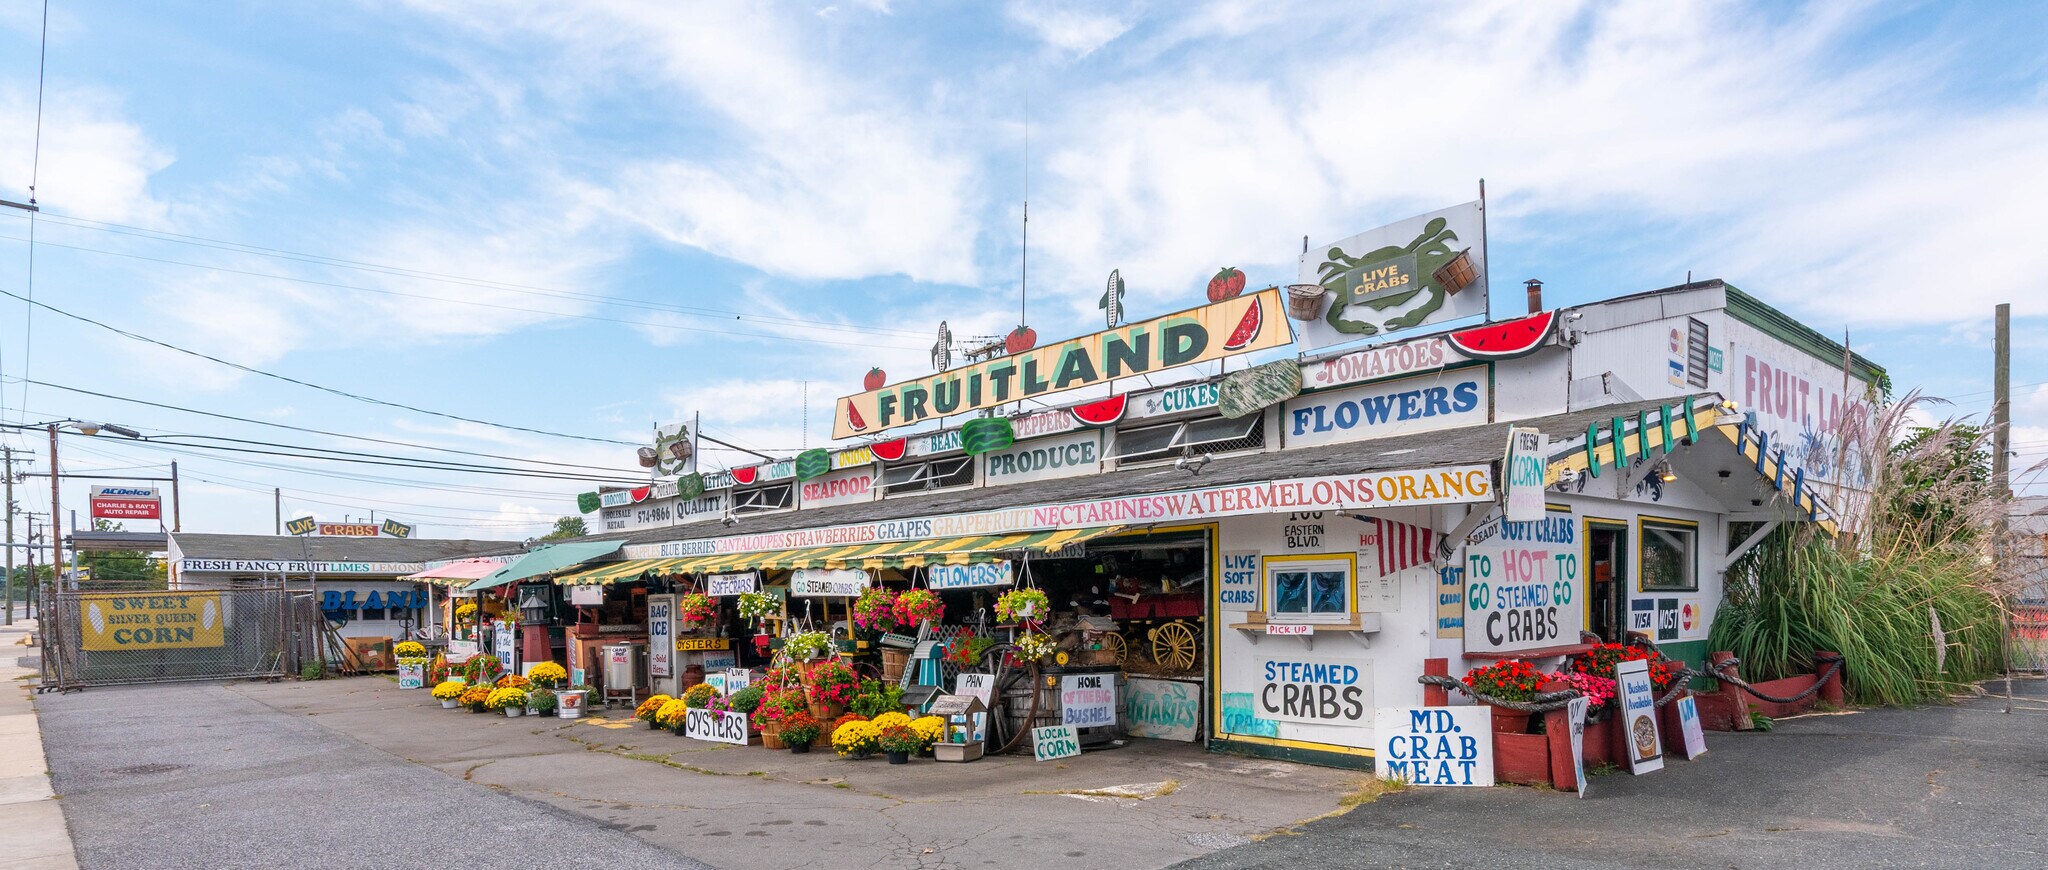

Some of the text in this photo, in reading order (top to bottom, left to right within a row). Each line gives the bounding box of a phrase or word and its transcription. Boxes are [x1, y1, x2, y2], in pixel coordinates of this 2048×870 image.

[1362, 265, 1398, 283] LIVE
[1354, 274, 1409, 296] CRABS
[1324, 340, 1443, 383] TOMATOES
[878, 317, 1210, 427] FRUITLAND
[1163, 382, 1219, 412] CUKES
[1745, 355, 1809, 427] FRUIT
[1293, 381, 1478, 436] FLOWERS
[1016, 409, 1071, 437] PEPPERS
[1519, 433, 1539, 452] FRESH
[839, 447, 871, 467] ONIONS
[990, 441, 1095, 476] PRODUCE
[771, 461, 791, 479] CORN
[1511, 455, 1545, 487] CORN
[704, 470, 732, 489] LETTUCE
[803, 475, 870, 502] SEAFOOD
[101, 488, 151, 496] ACDelco
[604, 491, 627, 505] BROCCOLI
[602, 509, 631, 519] WHOLESALE
[661, 543, 680, 557] BLUE
[681, 540, 716, 555] BERRIES
[716, 533, 784, 553] CANTALOUPES
[785, 525, 875, 548] STRAWBERRIES
[877, 519, 931, 539] GRAPES
[933, 508, 1034, 536] GRAPEFRUIT
[1033, 495, 1164, 528] NECTARINES
[1164, 478, 1374, 516] WATERMELONS
[1376, 470, 1489, 501] ORANG
[677, 496, 722, 519] QUALITY
[288, 518, 409, 536] LIVE CRABS LIVE
[607, 520, 625, 530] RETAIL
[1284, 524, 1324, 536] EASTERN
[1535, 518, 1574, 544] CRABS
[1288, 536, 1320, 548] BLVD.
[183, 560, 424, 573] FRESH FANCY FRUIT LIMES LEMONS
[1225, 555, 1256, 569] LIVE
[1469, 549, 1577, 582] TO HOT TO
[855, 572, 864, 580] TO
[938, 564, 996, 586] FLOWERS
[1225, 571, 1254, 585] SOFT
[806, 580, 832, 593] STEAMED
[1468, 581, 1572, 610] GO STEAMED GO
[113, 596, 190, 611] SWEET
[1220, 590, 1255, 603] CRABS
[109, 613, 197, 624] SILVER QUEEN
[651, 605, 668, 617] BAG
[1659, 609, 1679, 630] MOST
[651, 621, 668, 635] ICE
[1269, 625, 1307, 634] PICK UP
[1486, 607, 1558, 646] CRABS
[1634, 613, 1651, 629] VISA
[113, 626, 195, 645] CORN
[677, 640, 722, 650] OYSTERS
[731, 669, 744, 677] LIVE
[965, 674, 984, 688] PAN
[1264, 660, 1358, 685] STEAMED
[401, 678, 421, 687] CORN
[1078, 676, 1102, 689] HOME
[1627, 682, 1649, 695] Bushels
[1063, 688, 1112, 704] OF THE BIG
[1262, 682, 1363, 720] CRABS
[1628, 698, 1652, 711] Available
[1066, 706, 1112, 725] BUSHEL
[1410, 709, 1461, 733] MD.
[687, 710, 743, 740] OYSTERS
[1037, 726, 1070, 739] LOCAL
[1038, 740, 1077, 759] CORN
[1388, 735, 1477, 760] CRAB
[1386, 760, 1476, 785] MEAT
